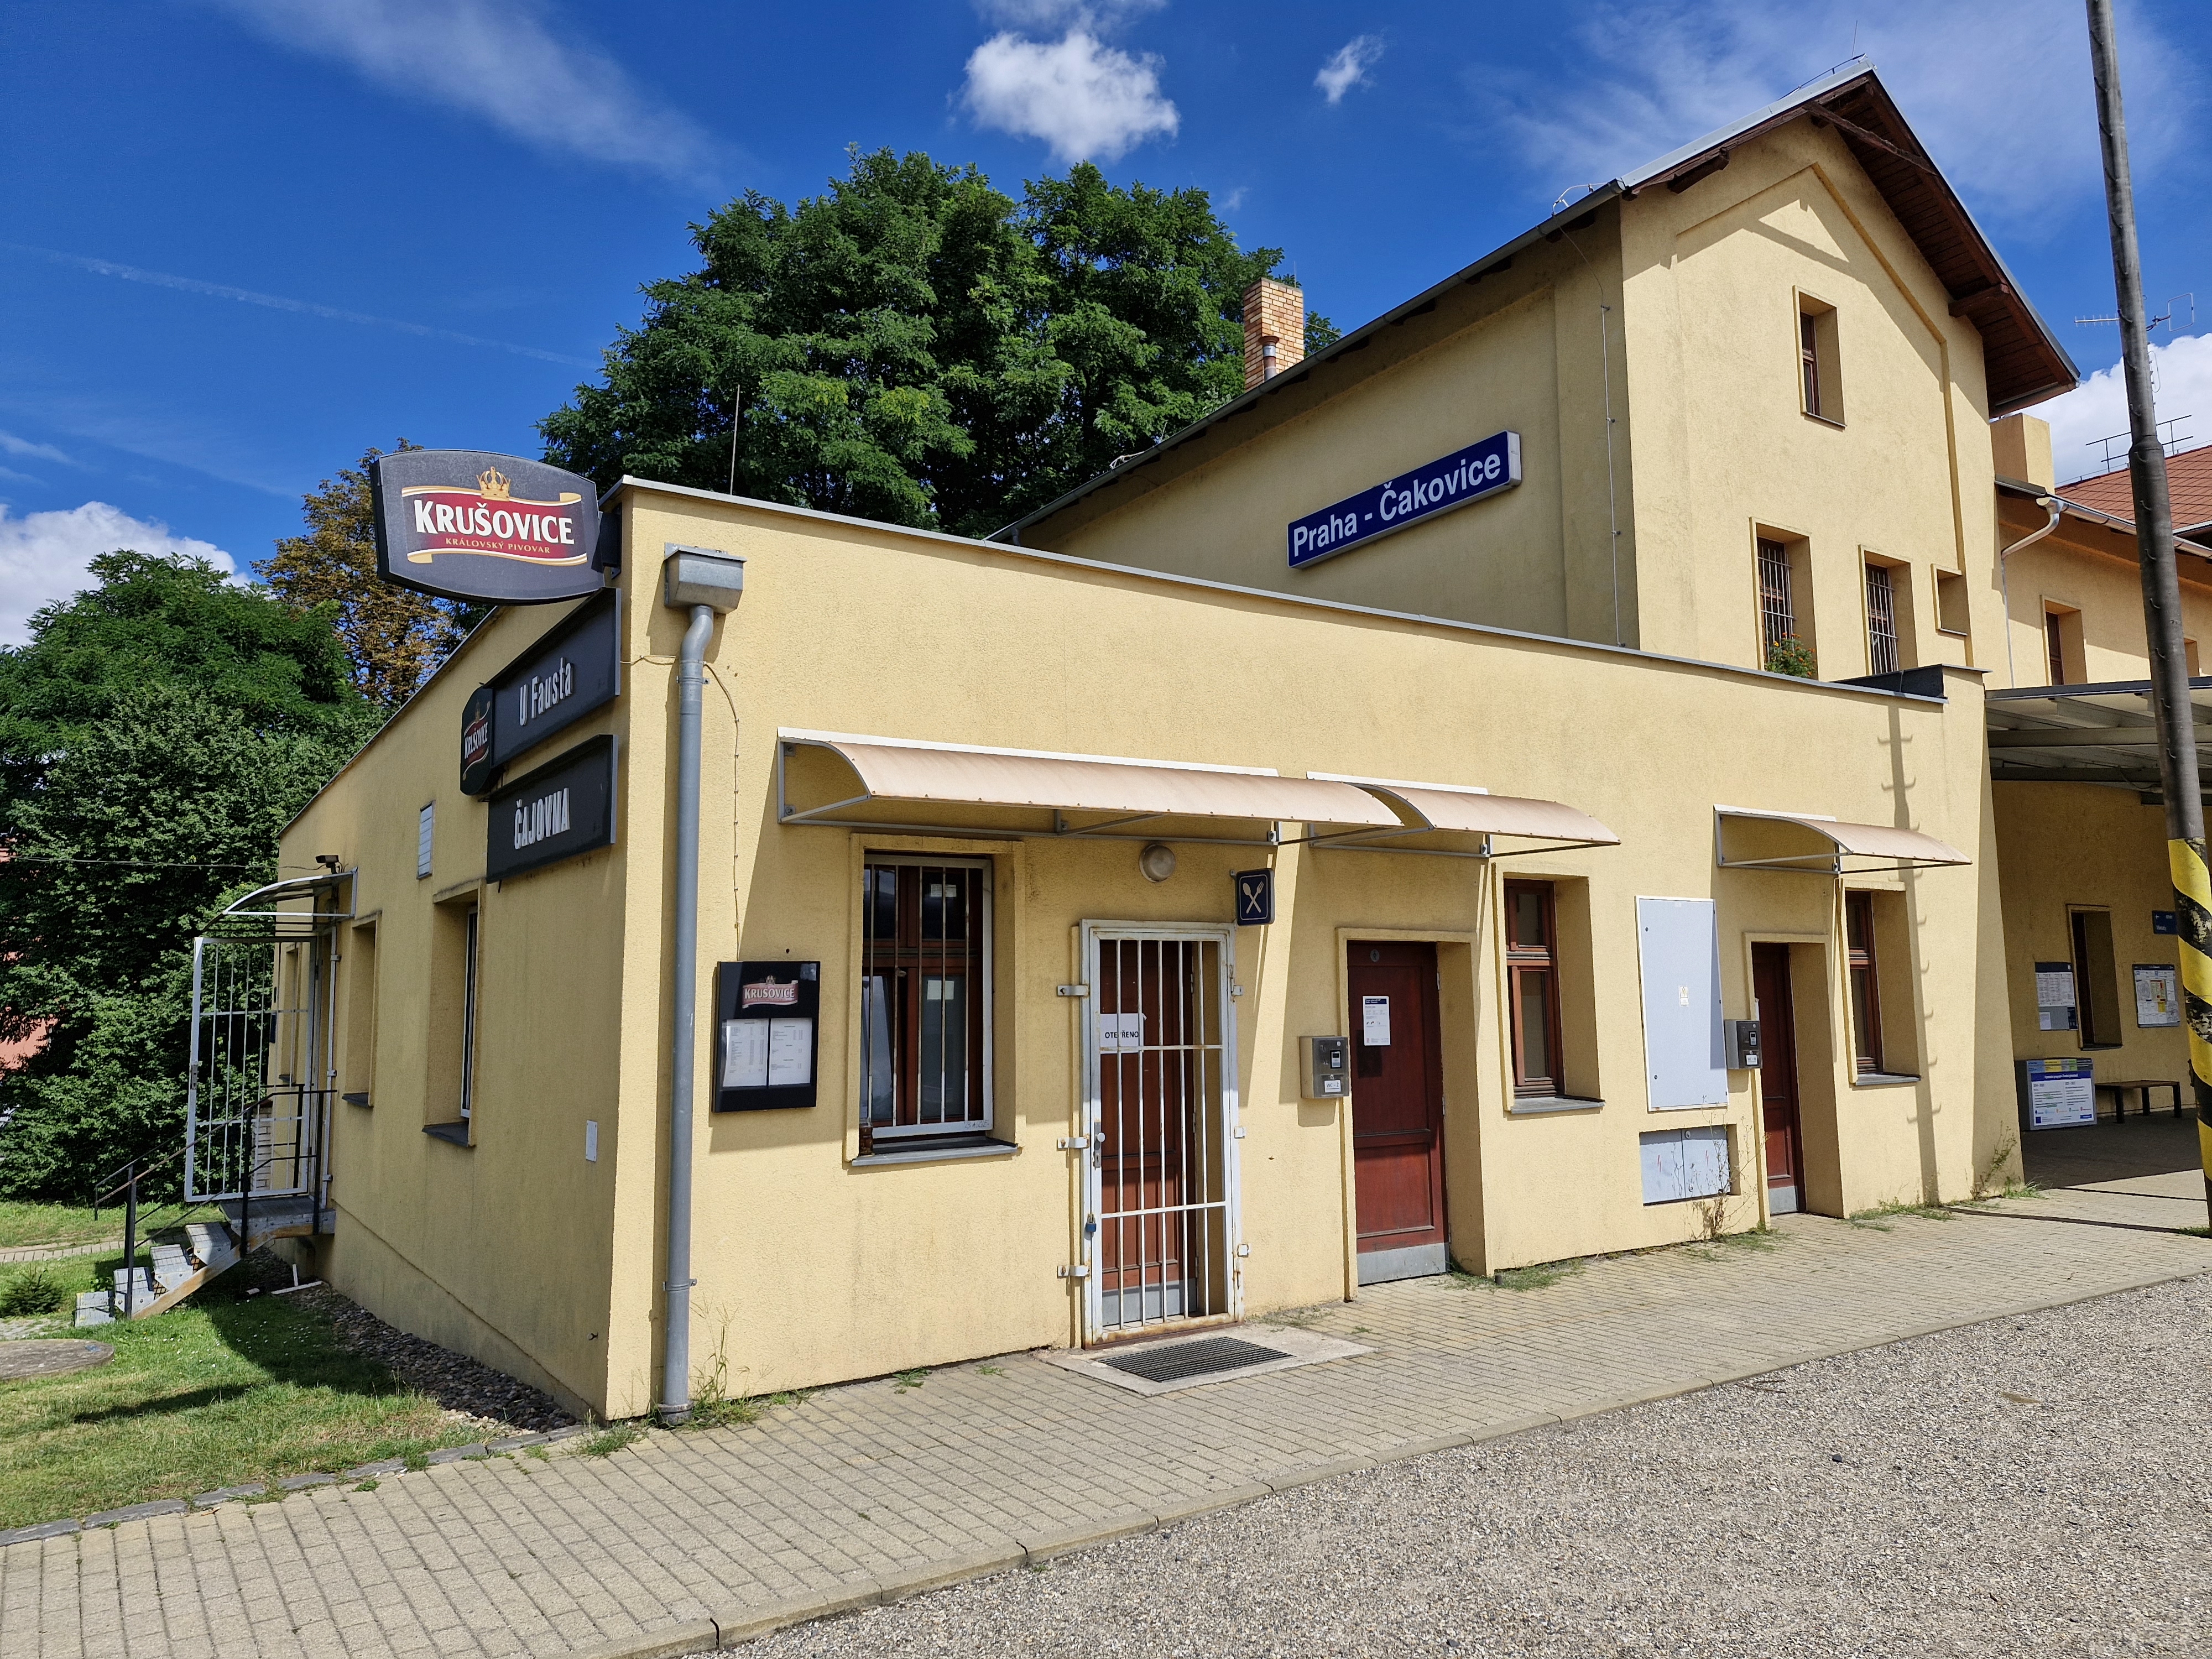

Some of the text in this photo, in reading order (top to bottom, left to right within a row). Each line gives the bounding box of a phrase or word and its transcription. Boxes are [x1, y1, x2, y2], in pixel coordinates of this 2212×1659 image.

[414, 499, 575, 545] KRUŠOVICE
[1294, 513, 1358, 557] Praha
[1380, 453, 1501, 521] Čakovice
[446, 538, 551, 554] KRÁLOVSKÝ PIVOVAR
[519, 656, 574, 726] U Fausta
[465, 721, 488, 759] KRUŠOVICE
[514, 787, 570, 850] ČAJOVNA
[745, 987, 795, 999] KRUŠOVICE
